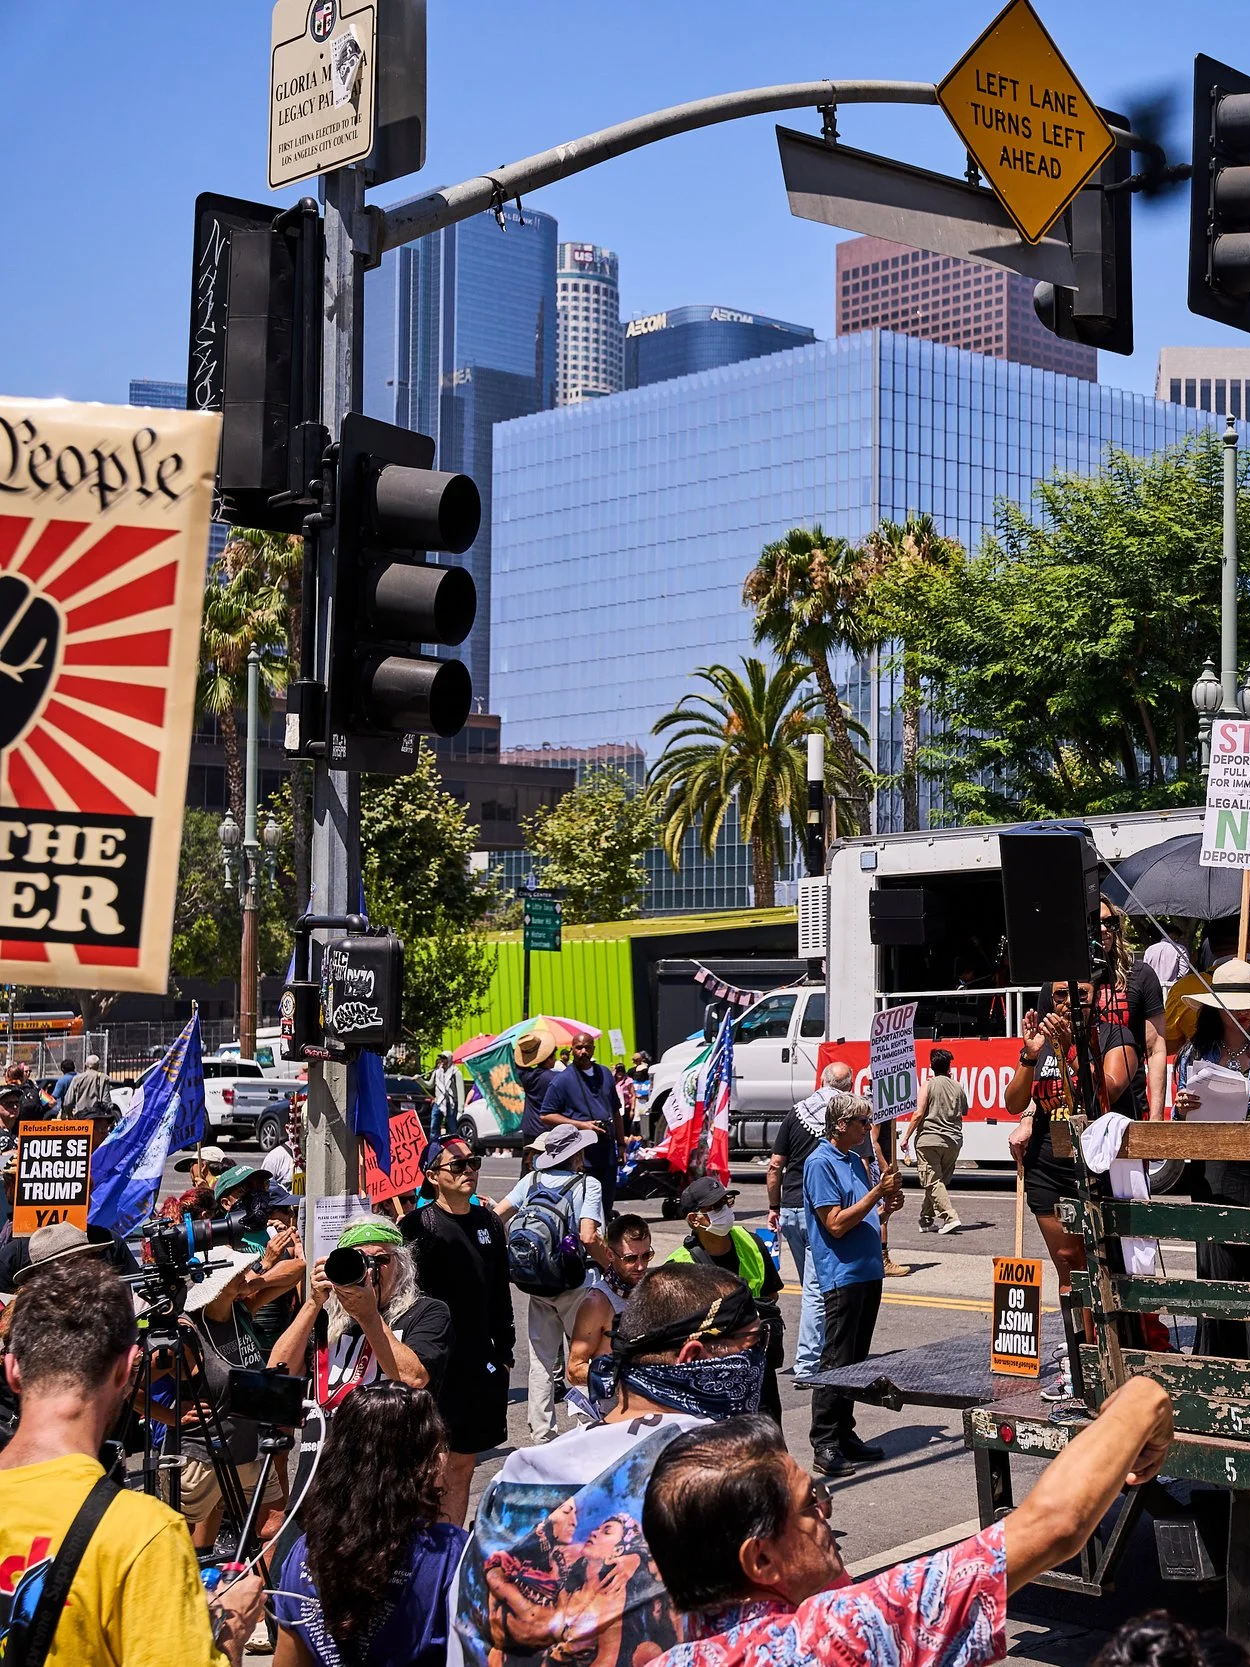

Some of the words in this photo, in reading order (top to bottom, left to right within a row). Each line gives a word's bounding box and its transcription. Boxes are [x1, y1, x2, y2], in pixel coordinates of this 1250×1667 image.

[276, 72, 317, 102] GLORIA
[976, 69, 1020, 102] LEFT
[1030, 84, 1078, 118] LANE
[278, 102, 316, 126] LEGACY
[318, 78, 364, 110] PATAY
[278, 140, 294, 154] FIRST
[294, 132, 314, 150] LATINA
[316, 124, 340, 144] ELECTED
[341, 120, 350, 132] TO
[350, 114, 362, 128] THE
[970, 102, 1032, 139] TURNS
[1042, 122, 1086, 152] LEFT
[281, 155, 292, 166] LOS
[293, 146, 318, 163] ANGELES
[319, 140, 332, 153] CITY
[334, 130, 358, 148] COUNCIL
[1000, 146, 1062, 180] AHEAD
[626, 313, 667, 338] AECOM
[710, 308, 754, 324] AECOM
[1224, 768, 1247, 776] FULL
[1210, 778, 1230, 788] FOR
[0, 820, 126, 868] THE
[874, 1006, 914, 1036] STOP
[872, 1027, 912, 1046] DEPORTATIONS!
[876, 1044, 890, 1054] FULL
[890, 1039, 908, 1050] RIGHTS
[871, 1054, 882, 1064] FOR
[882, 1045, 914, 1061] IMMIGRANTS!
[872, 1060, 916, 1080] LEGALIZACIÓN!
[878, 1070, 912, 1110] NO
[874, 1100, 917, 1120] DEPORTACIÓN!
[24, 1124, 88, 1133] RefuseFascism.org
[22, 1140, 62, 1159] ¡QUE
[66, 1140, 88, 1157] SE
[20, 1160, 86, 1179] LARGUE
[22, 1182, 82, 1200] TRUMP
[1000, 1263, 1036, 1283] NOW!
[1008, 1288, 1025, 1309] GO
[1000, 1310, 1033, 1332] MUST
[994, 1333, 1037, 1356] TRUMP
[994, 1357, 1038, 1370] RefuseFascism.org
[1230, 1406, 1242, 1431] 5
[1225, 1456, 1237, 1482] 5
